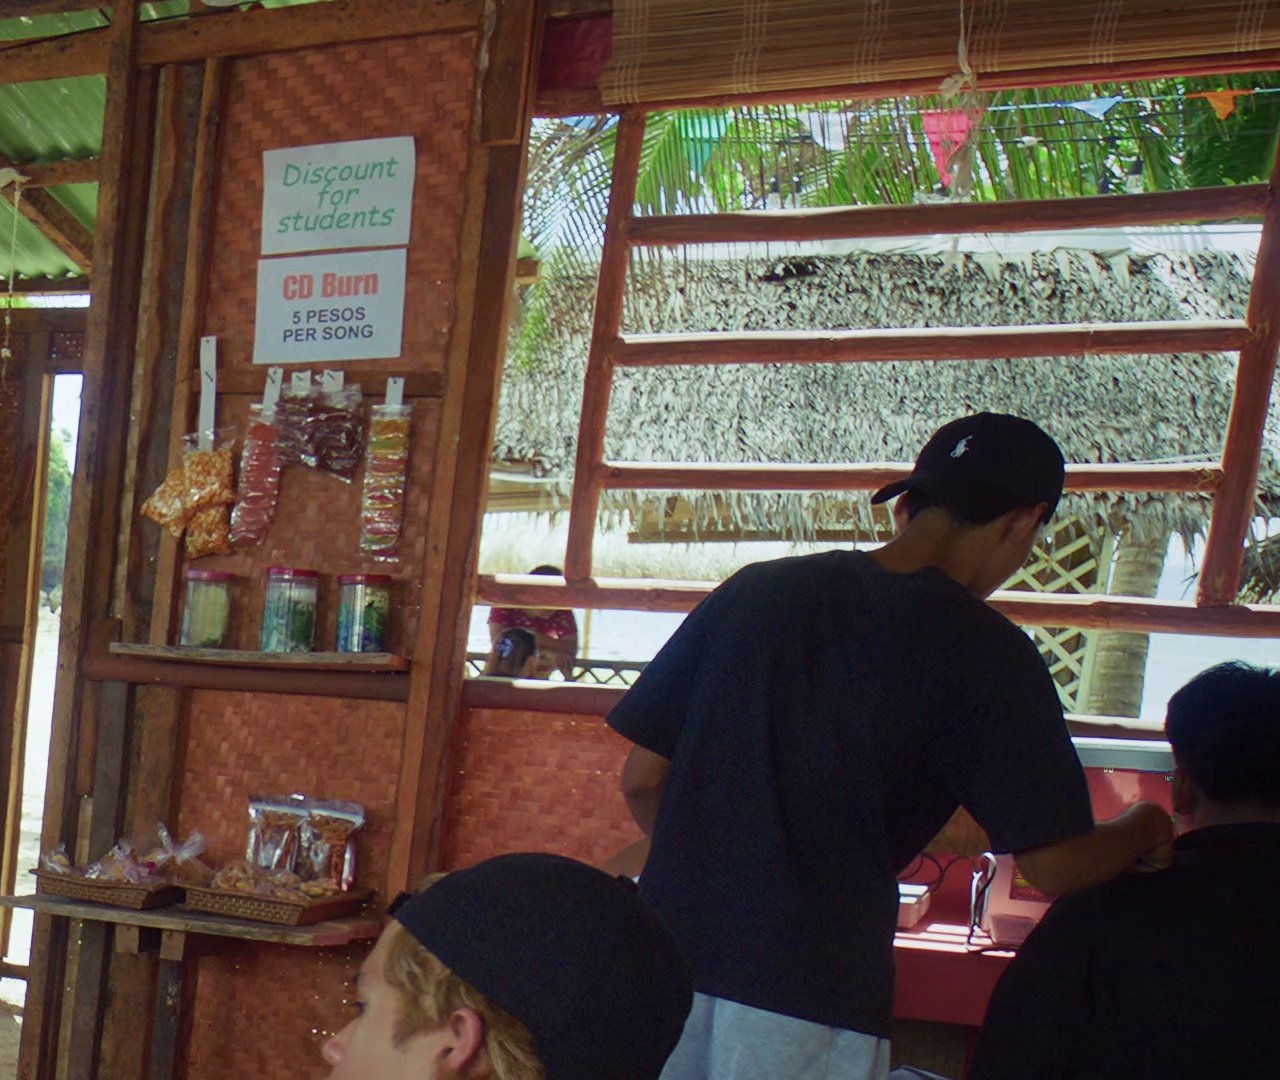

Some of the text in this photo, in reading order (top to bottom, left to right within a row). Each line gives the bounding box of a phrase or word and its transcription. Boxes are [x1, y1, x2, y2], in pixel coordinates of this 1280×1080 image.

[282, 157, 398, 186] Discount
[318, 185, 359, 208] for
[277, 206, 395, 233] students
[282, 273, 378, 300] CD Burn
[292, 307, 366, 324] 5 PESOS
[283, 324, 374, 343] PER SONG
